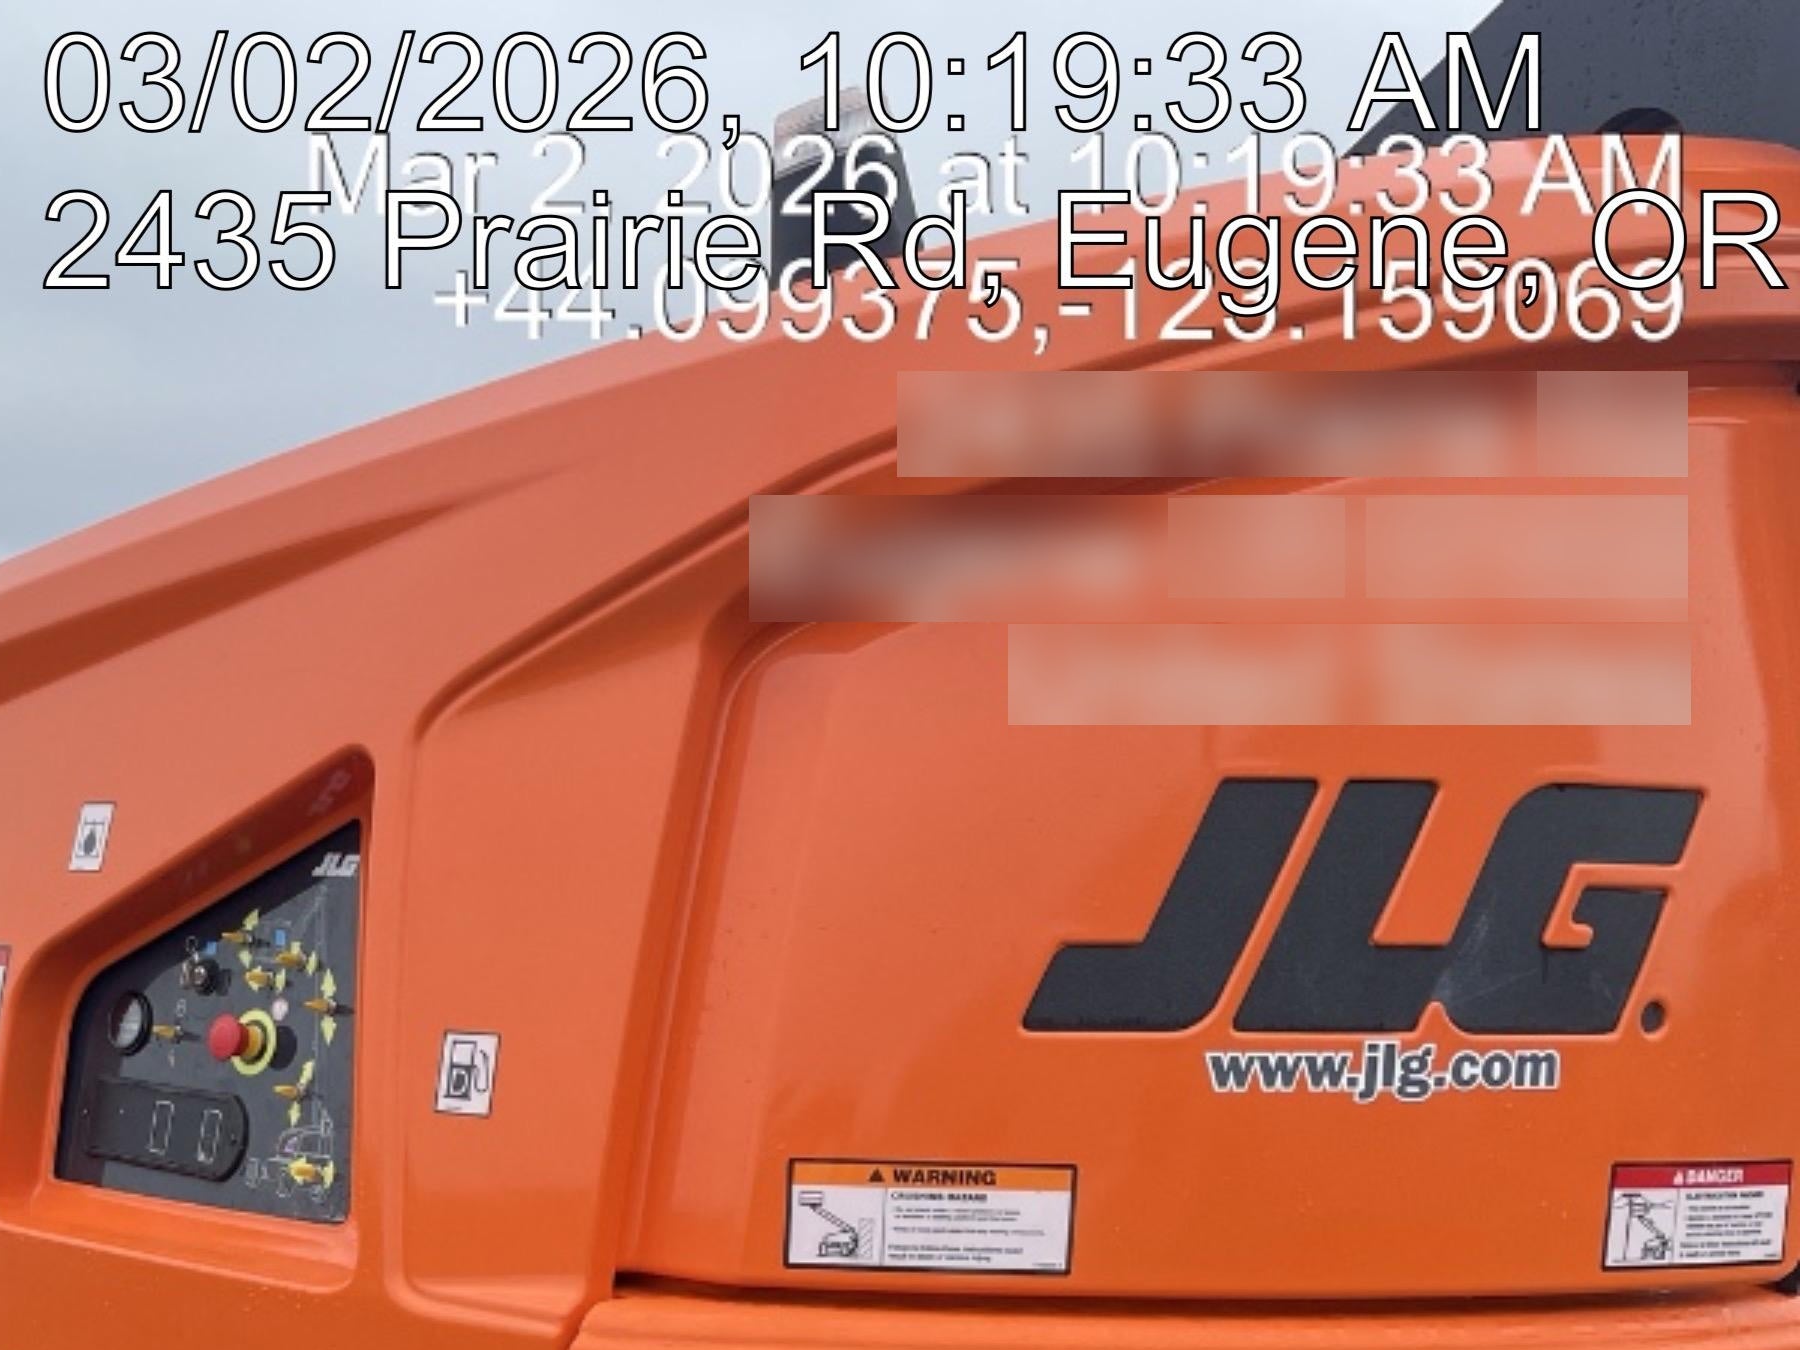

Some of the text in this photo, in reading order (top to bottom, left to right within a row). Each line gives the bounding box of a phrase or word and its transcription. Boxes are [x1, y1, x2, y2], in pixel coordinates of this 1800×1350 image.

[1020, 776, 1706, 1036] JLG
[1205, 1040, 1561, 1101] www.jlg.com
[893, 1168, 997, 1186] WARNING
[1685, 1168, 1745, 1184] DANGER
